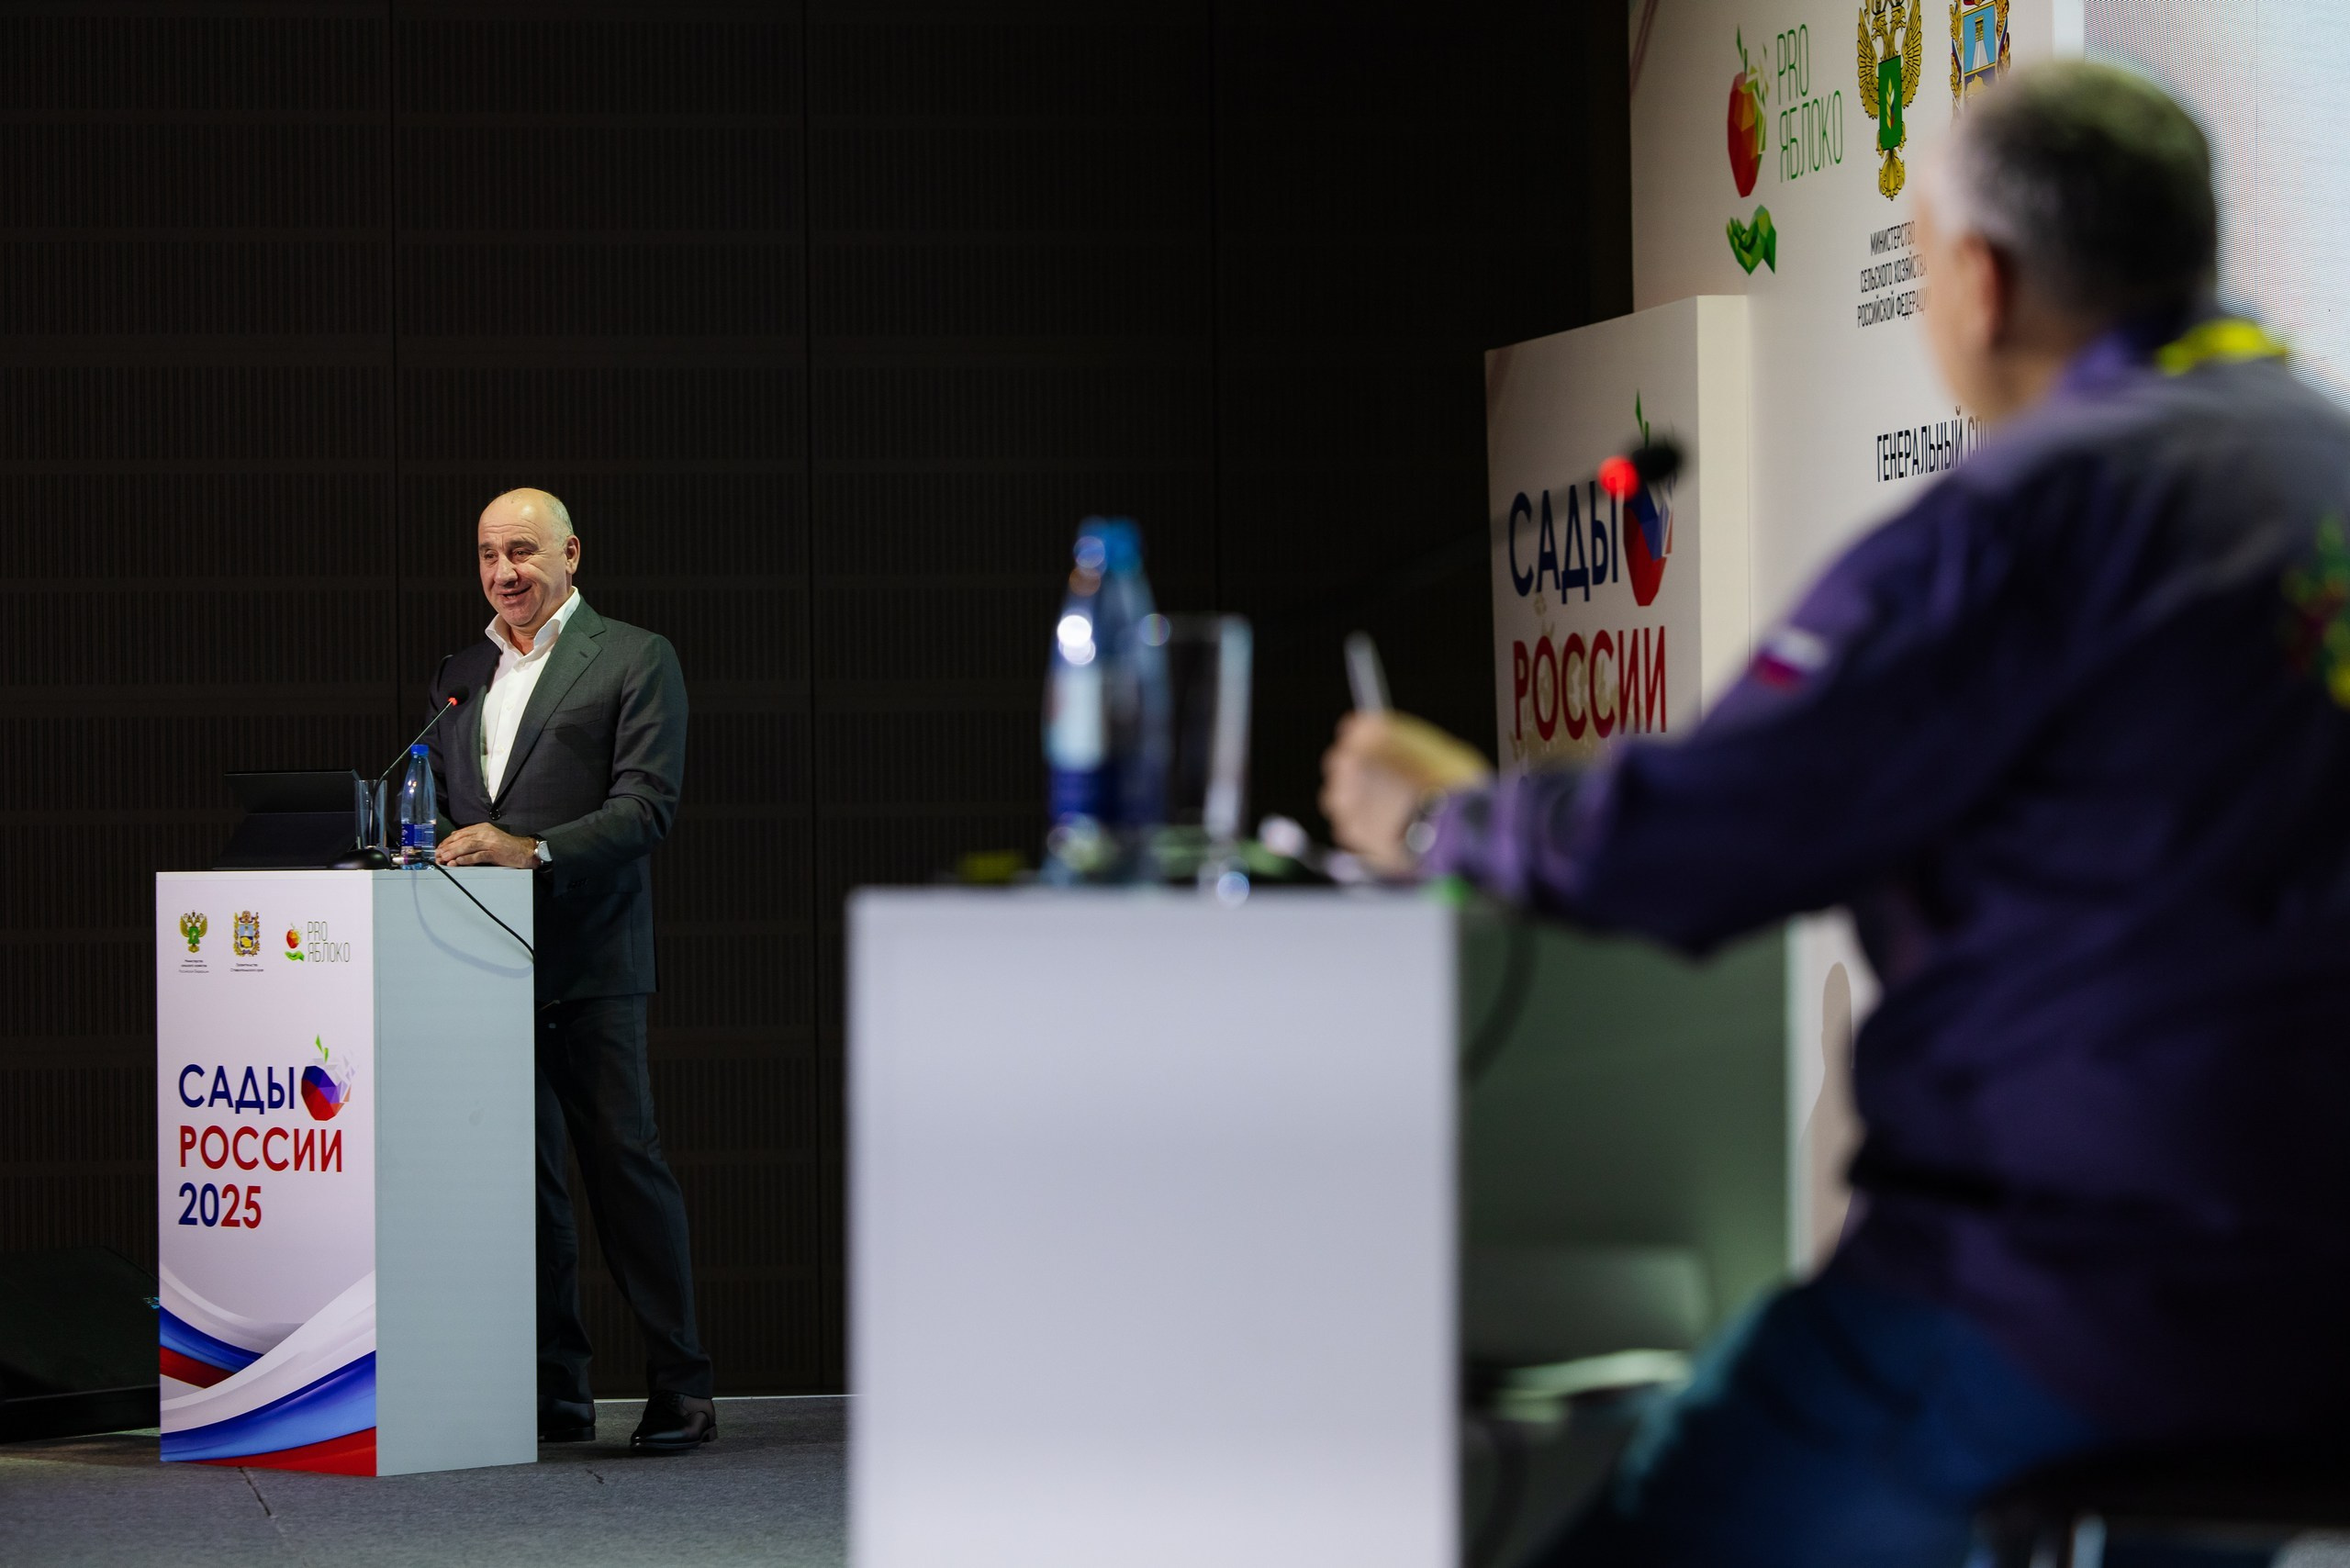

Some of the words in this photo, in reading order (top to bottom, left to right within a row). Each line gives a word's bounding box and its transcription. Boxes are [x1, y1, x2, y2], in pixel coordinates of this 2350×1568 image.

[1776, 23, 1809, 106] PRO
[1779, 90, 1843, 183] ЯБЛОКО
[1870, 220, 1916, 256] МИНИСТЕРСТВО
[1860, 262, 1892, 293] СЕЛЬСКОГО
[1857, 290, 1896, 329] РОССИЙСКОЙ
[1876, 406, 1964, 483] ГЕНЕРАЛЬНЫЙ
[1508, 477, 1619, 604] САДЫ
[1513, 625, 1667, 741] РОССИИ
[307, 921, 329, 942] PRO
[307, 942, 351, 963] ЯБЛОКО
[178, 1063, 295, 1114] САДЫ
[179, 1125, 342, 1172] РОССИИ
[178, 1182, 262, 1229] 2025
